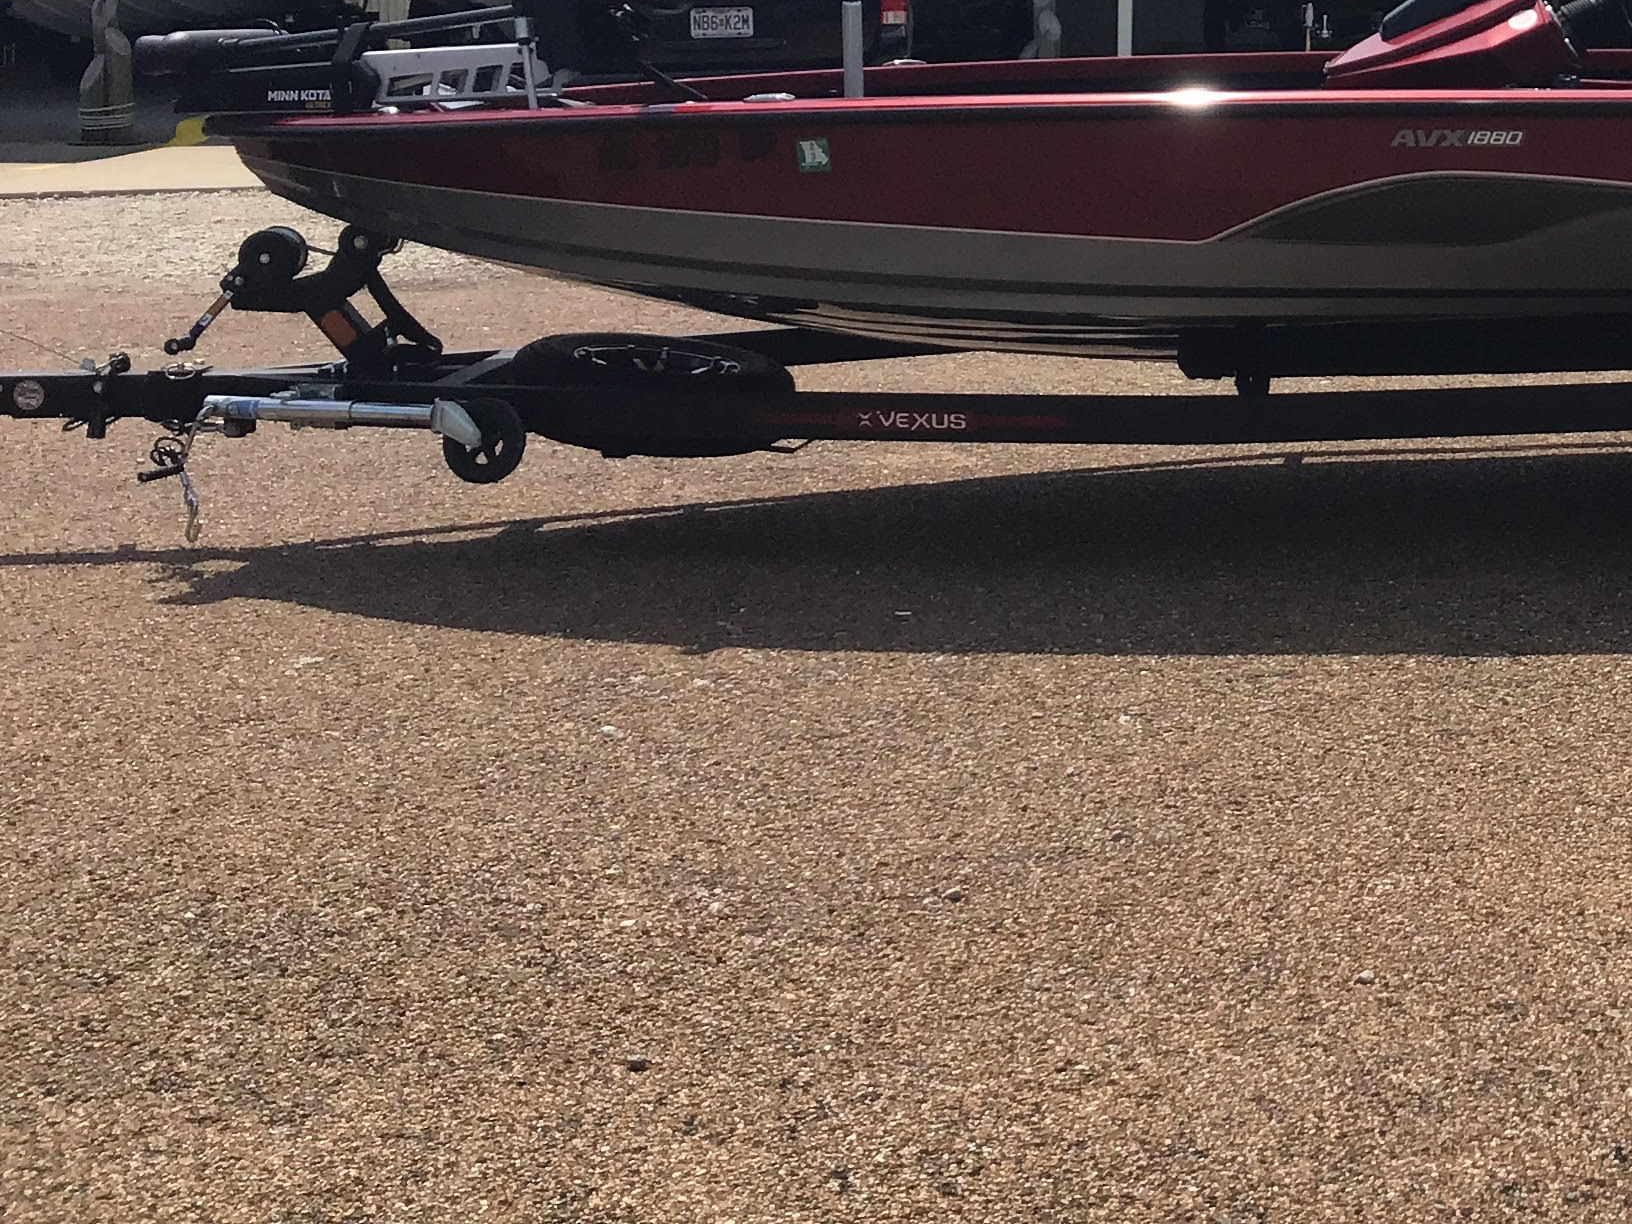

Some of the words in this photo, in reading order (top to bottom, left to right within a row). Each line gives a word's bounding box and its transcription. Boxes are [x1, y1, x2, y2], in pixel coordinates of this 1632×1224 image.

[267, 89, 299, 102] MINN
[300, 88, 332, 101] KOTA
[876, 410, 967, 431] VEXUS
